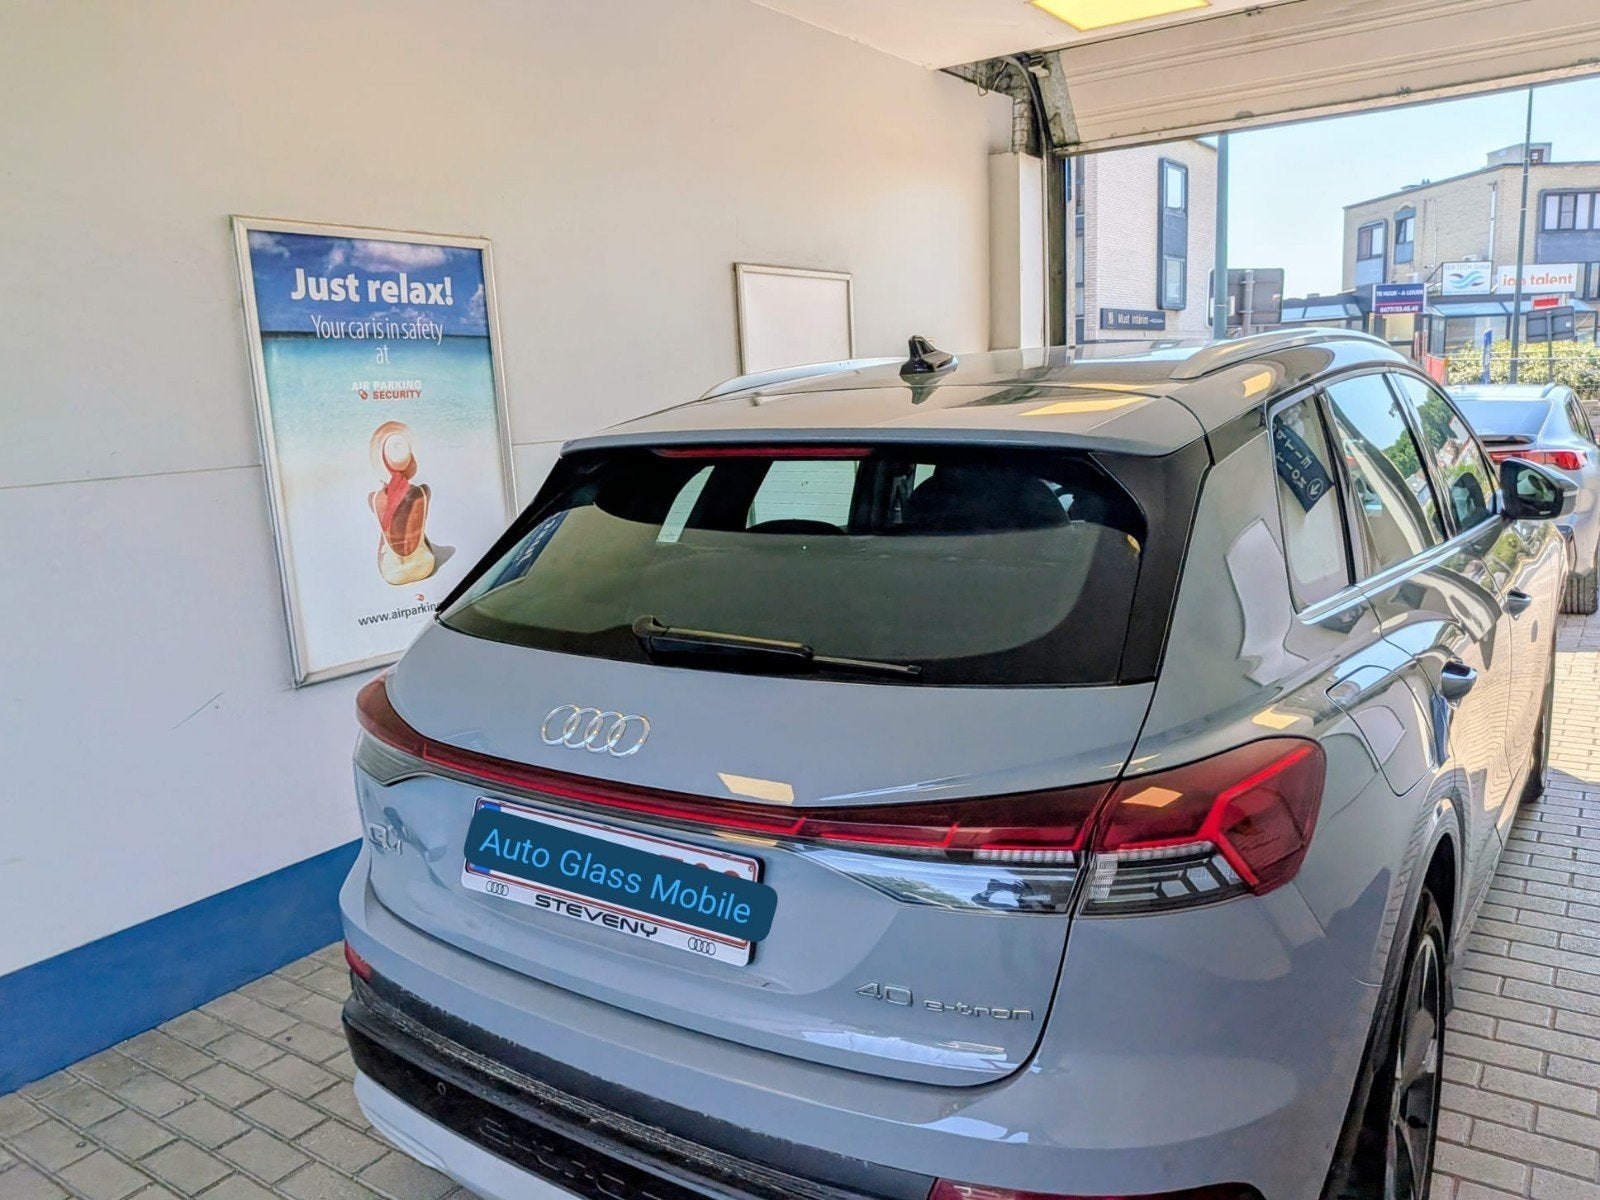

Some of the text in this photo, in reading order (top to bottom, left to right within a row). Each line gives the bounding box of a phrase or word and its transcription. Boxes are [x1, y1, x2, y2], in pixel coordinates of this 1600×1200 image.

[291, 268, 454, 306] Just relax!
[1530, 273, 1574, 285] talent
[311, 313, 443, 346] Your car is in safety
[376, 345, 391, 365] at
[351, 380, 422, 391] AIR PARKING
[372, 390, 422, 400] SECURITY
[534, 893, 659, 938] STEVENY
[855, 981, 1035, 1022] 40 e-tron
